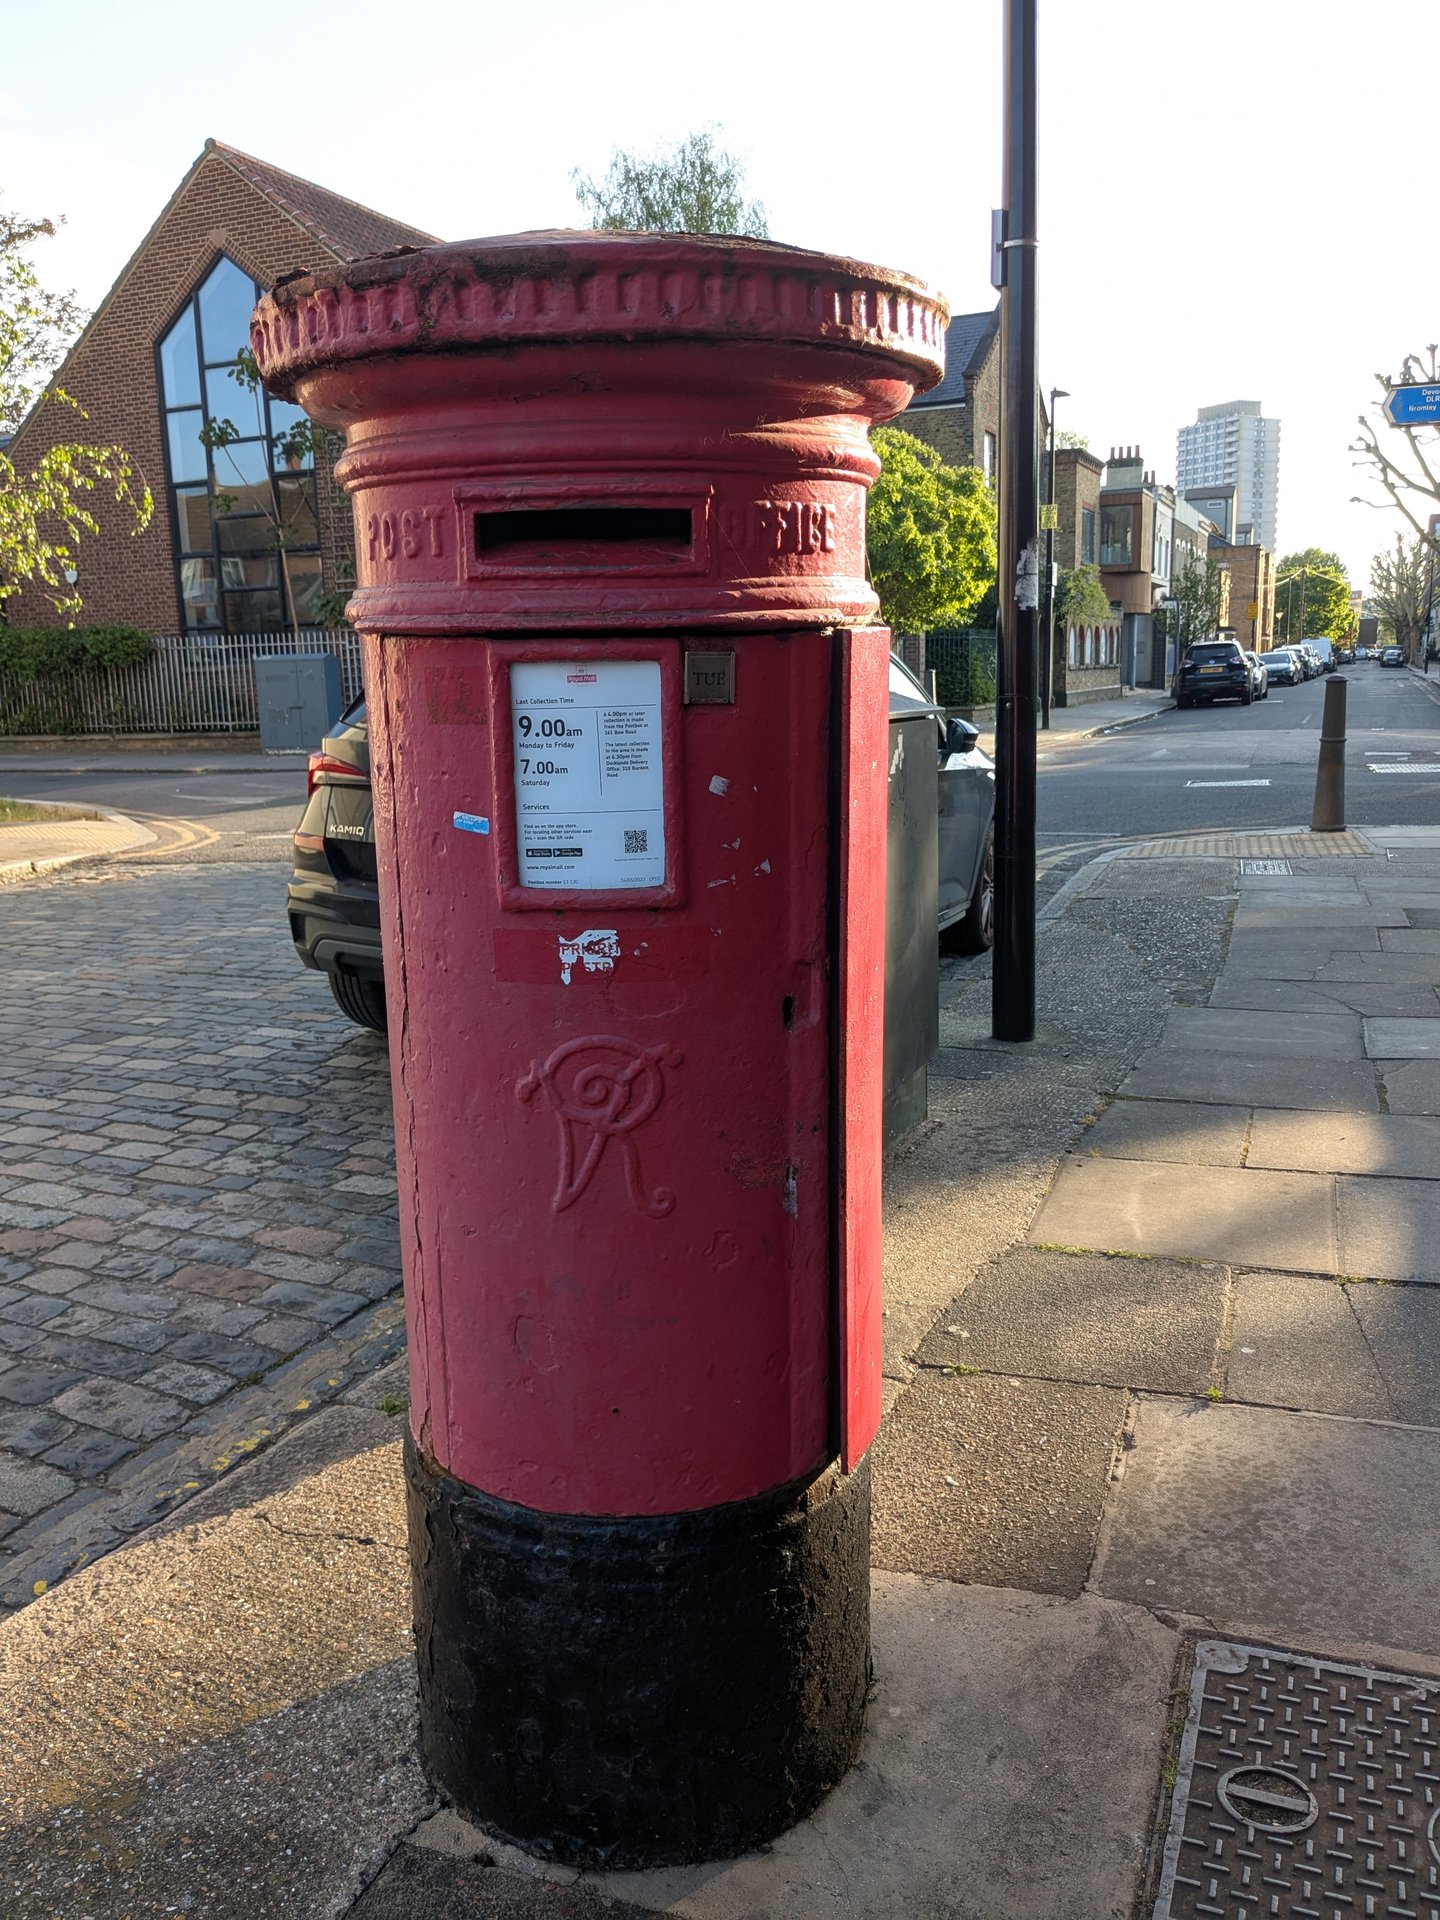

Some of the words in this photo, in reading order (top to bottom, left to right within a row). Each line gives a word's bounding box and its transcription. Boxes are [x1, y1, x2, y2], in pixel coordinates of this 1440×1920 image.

[368, 505, 446, 561] POST
[692, 672, 726, 686] TUE
[518, 716, 582, 738] 9.00am
[520, 759, 568, 774] 7.00am
[330, 824, 365, 837] KAMIQ
